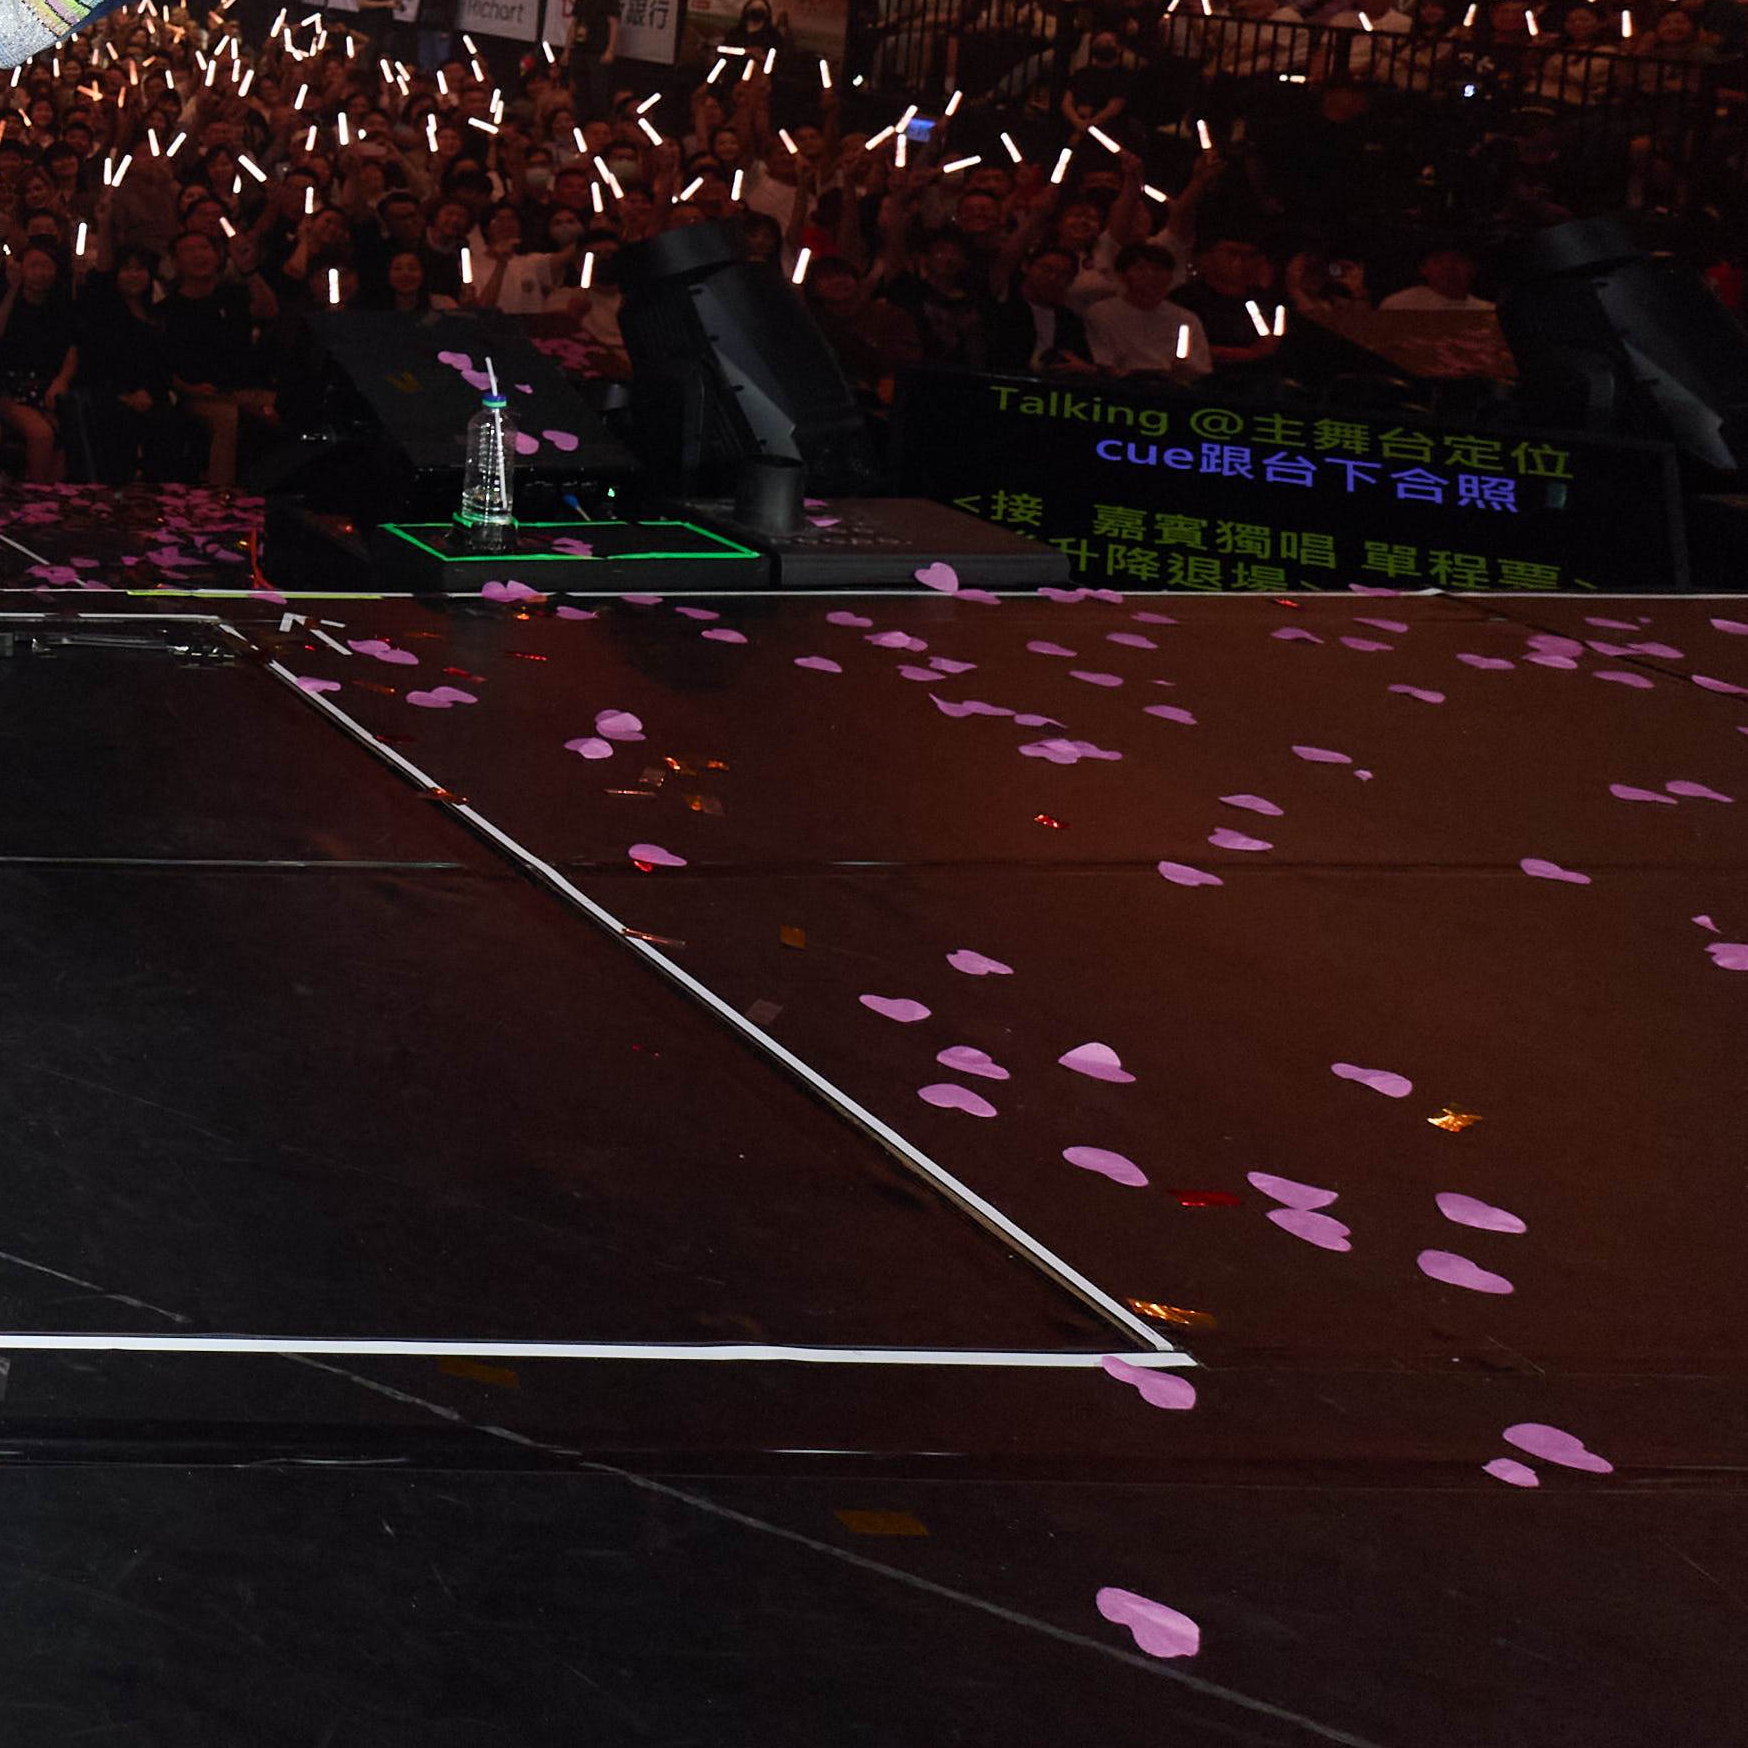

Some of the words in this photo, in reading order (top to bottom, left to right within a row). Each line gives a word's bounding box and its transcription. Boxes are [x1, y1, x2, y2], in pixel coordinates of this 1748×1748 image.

[989, 385, 1170, 435] Talking
[1189, 407, 1575, 480] @主舞台定位
[1095, 437, 1519, 514] cue跟台下合照
[1092, 502, 1337, 570] 嘉賓獨唱
